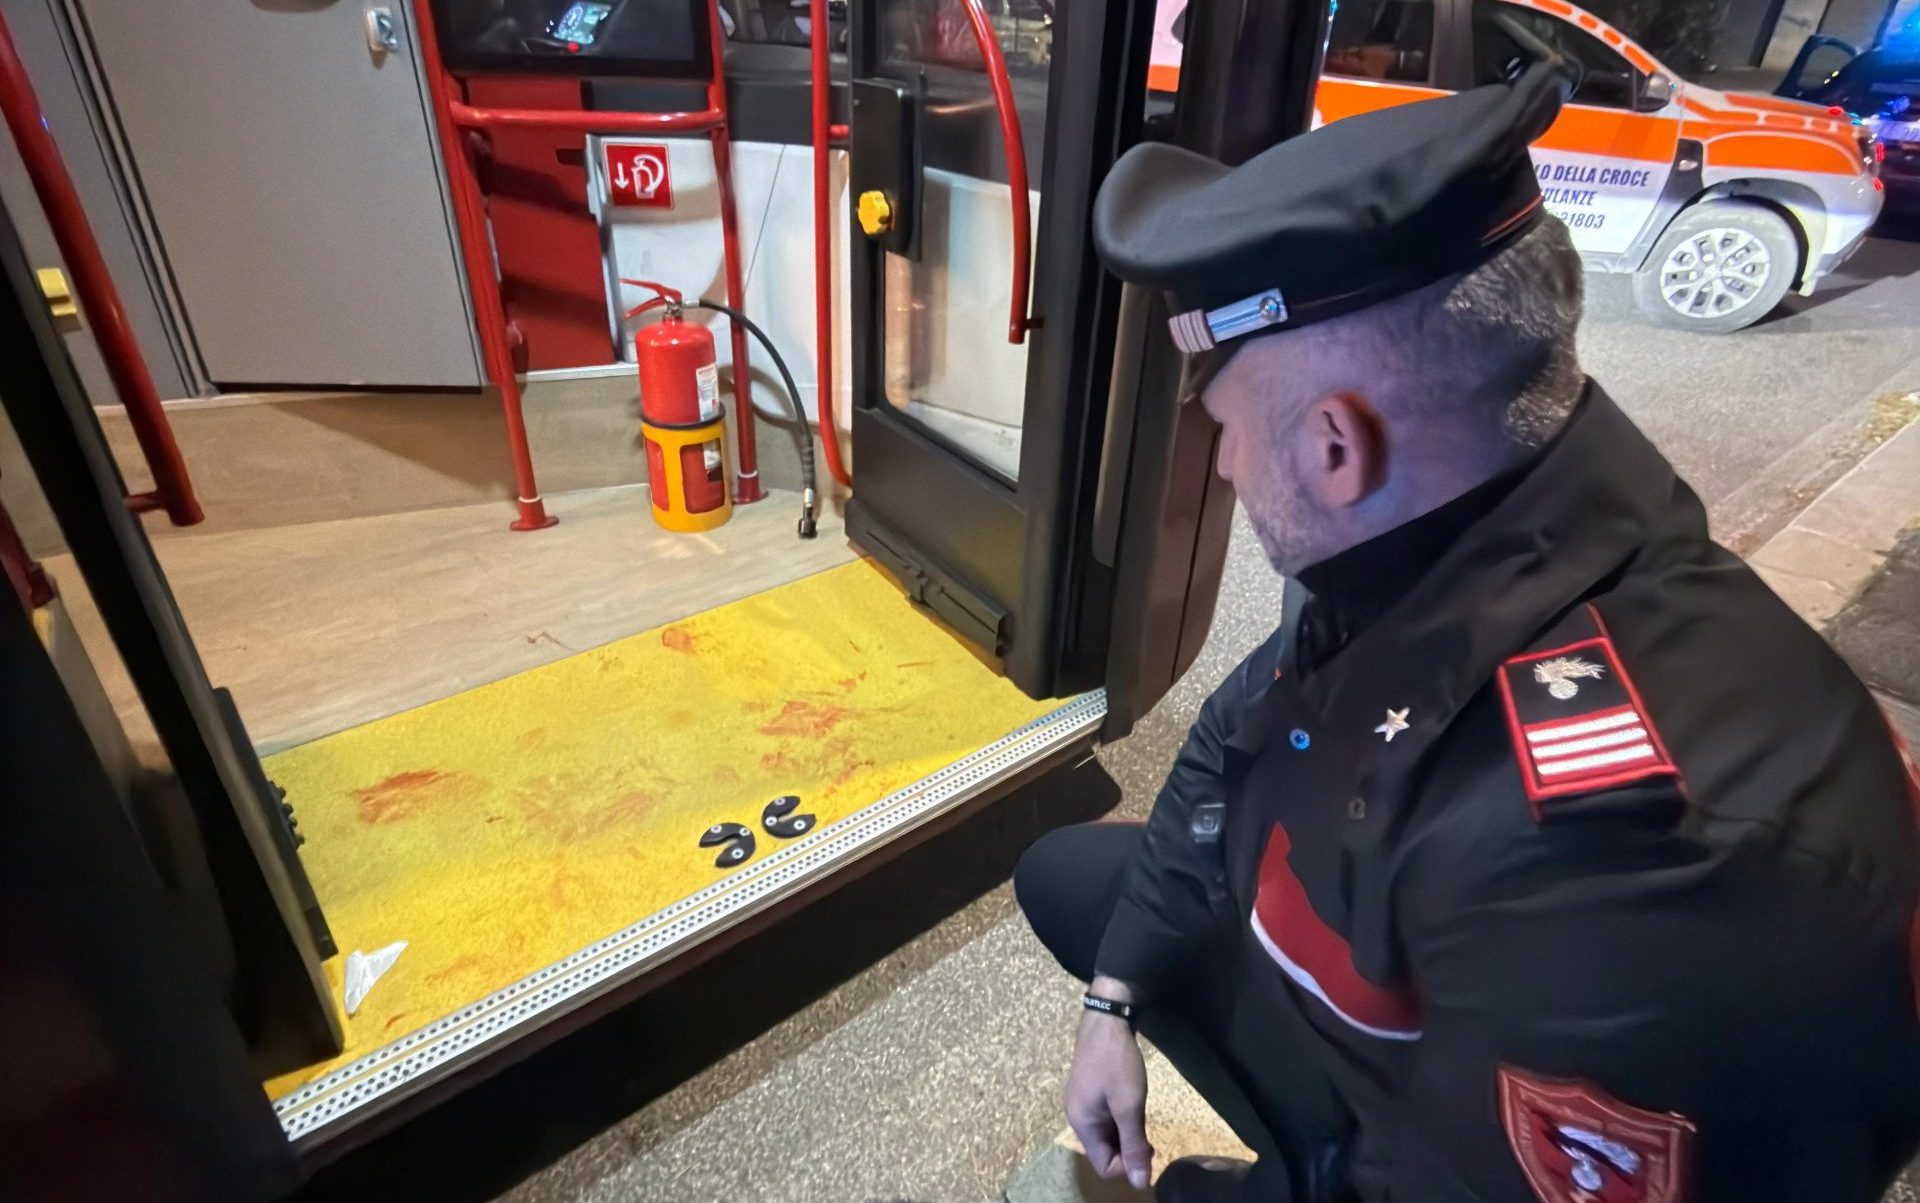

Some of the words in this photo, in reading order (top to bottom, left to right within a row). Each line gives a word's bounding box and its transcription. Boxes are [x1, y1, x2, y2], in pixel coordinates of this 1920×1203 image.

[1553, 165, 1597, 182] DELLA
[1600, 168, 1651, 187] CROCE
[1541, 187, 1598, 206] ULANZE
